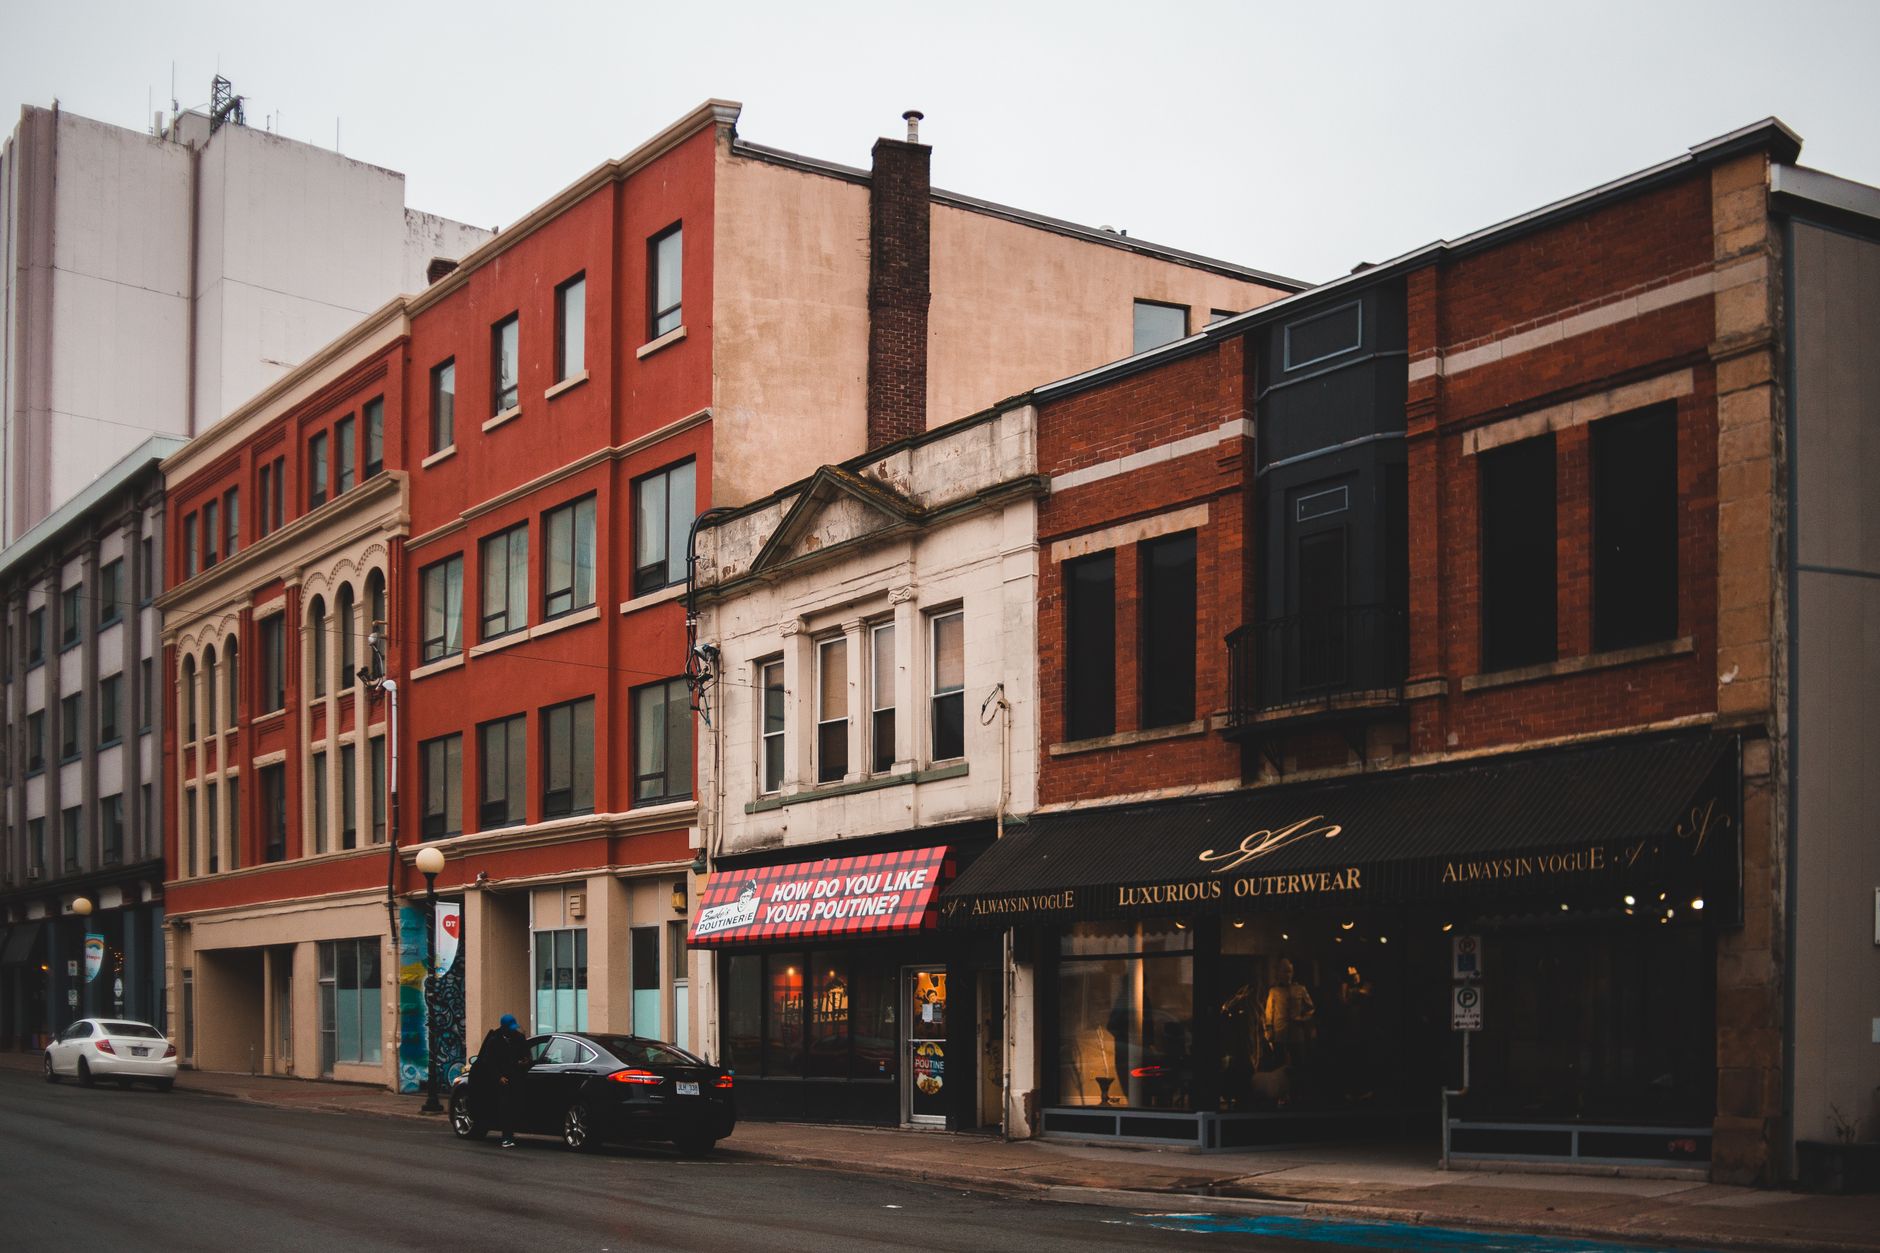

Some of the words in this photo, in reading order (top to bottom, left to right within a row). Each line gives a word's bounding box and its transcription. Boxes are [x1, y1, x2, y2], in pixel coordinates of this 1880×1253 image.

[1442, 859, 1513, 883] ALWAYS
[1514, 856, 1534, 877] IN
[1537, 846, 1606, 874] VOGUE
[771, 882, 811, 903] HOW
[812, 878, 839, 900] DO
[844, 874, 883, 896] YOU
[882, 869, 928, 893] LIKE
[1118, 880, 1222, 906] LUXURIOUS
[1233, 867, 1362, 897] OUTERWEAR
[764, 902, 812, 924] YOUR
[811, 895, 901, 922] POUTINE?
[971, 898, 1017, 916] ALWAYS
[1018, 896, 1031, 912] IN
[1032, 890, 1075, 911] VOGUE
[445, 920, 457, 928] DT
[915, 1058, 945, 1070] POUTINE
